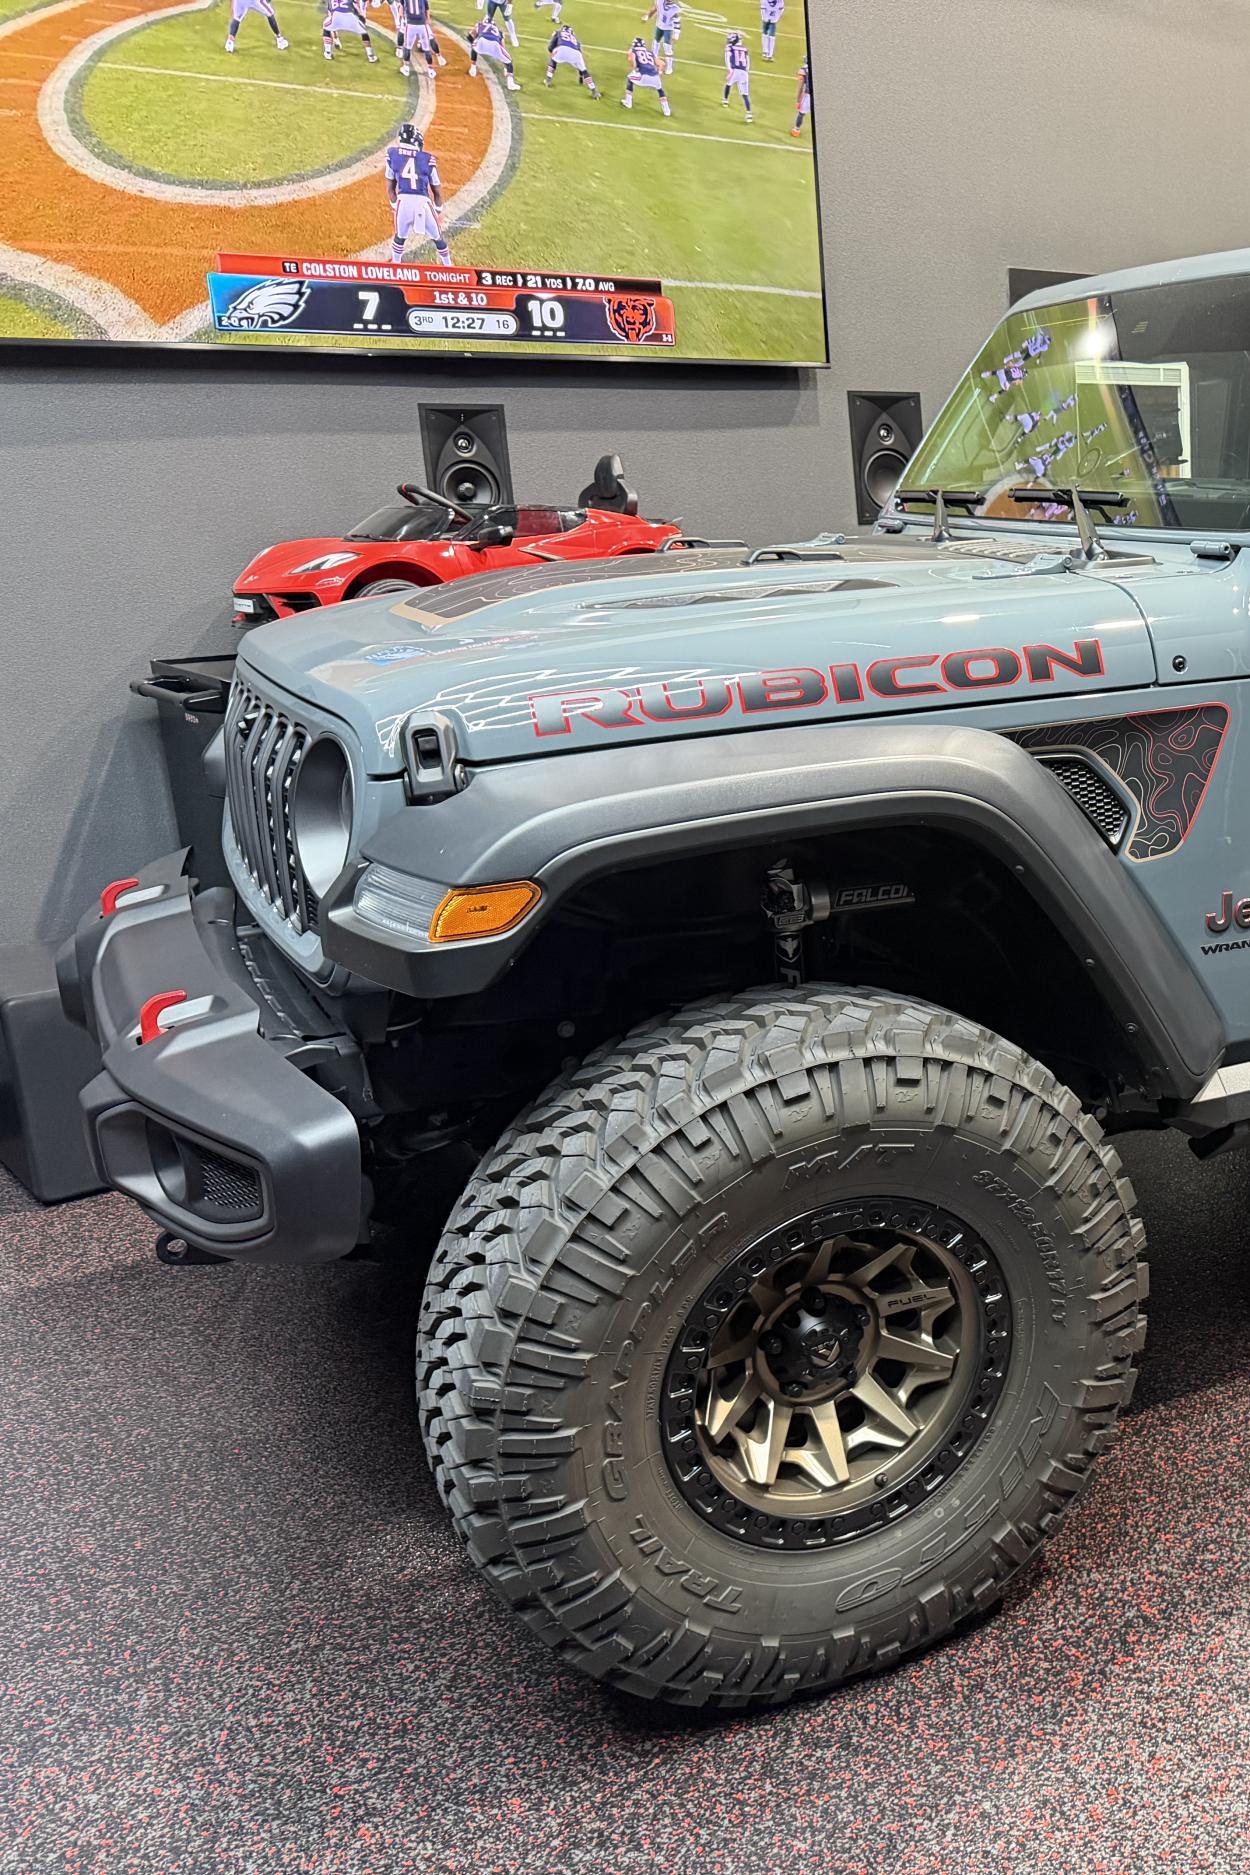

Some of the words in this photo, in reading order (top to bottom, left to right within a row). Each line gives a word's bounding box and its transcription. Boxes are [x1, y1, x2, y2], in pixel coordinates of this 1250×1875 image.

[638, 51, 654, 65] 85
[735, 50, 747, 67] 14
[402, 157, 418, 190] 4
[284, 262, 297, 272] TE
[302, 262, 358, 278] COLSTON
[362, 265, 420, 281] LOVELAND
[425, 271, 471, 284] TONIGHT
[481, 275, 492, 285] 3
[496, 277, 514, 286] REC
[527, 277, 542, 287] 21
[546, 279, 563, 289] YDS
[575, 279, 595, 291] 7.0
[599, 282, 615, 292] AVG
[358, 291, 380, 320] 7
[434, 291, 457, 304] 1st
[458, 293, 469, 304] &
[471, 293, 487, 306] 10
[414, 315, 434, 326] 3RD
[441, 315, 486, 331] 12:27
[496, 319, 510, 330] 16
[527, 300, 565, 328] 10
[529, 638, 1104, 737] RUBICON
[781, 1143, 915, 1191] M/T
[887, 1294, 937, 1309] FUEL
[602, 1211, 729, 1500] GRAPPLER
[629, 1513, 743, 1614] TRAIL
